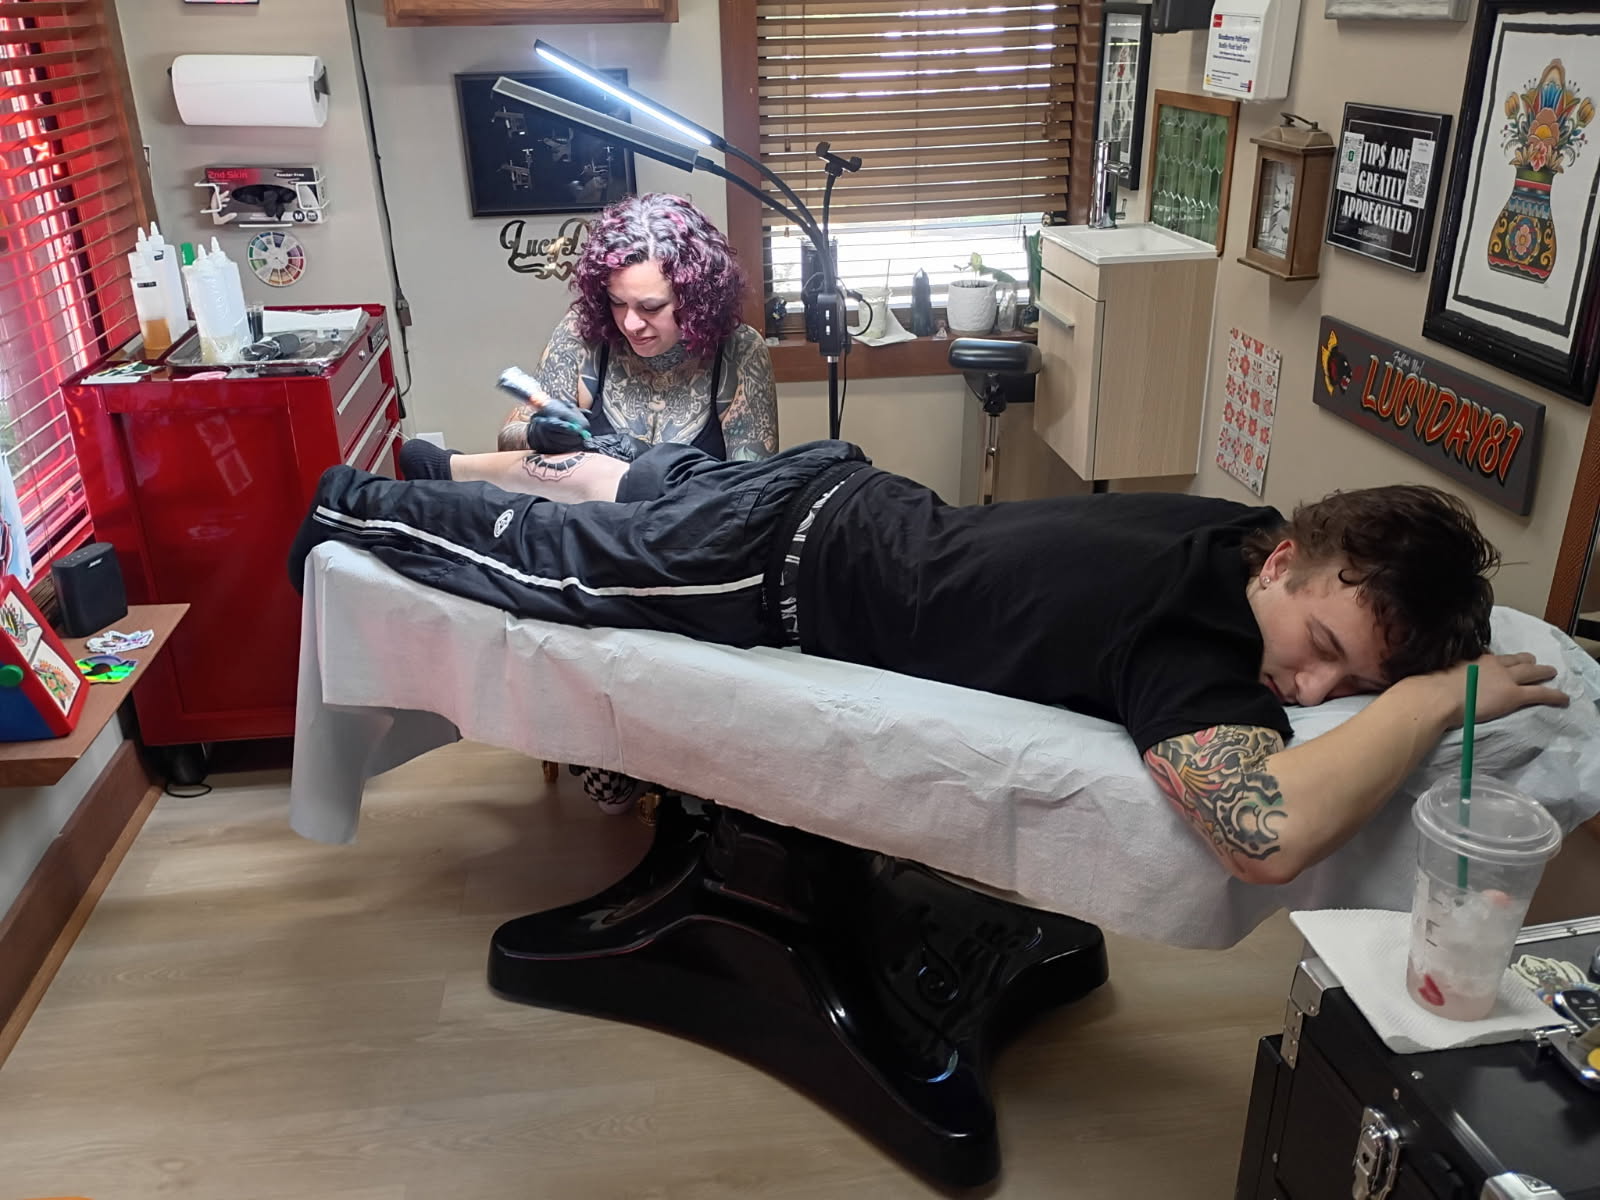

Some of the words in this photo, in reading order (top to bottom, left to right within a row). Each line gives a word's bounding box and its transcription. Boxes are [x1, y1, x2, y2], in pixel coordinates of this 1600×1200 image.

[207, 170, 226, 179] 2nd
[226, 169, 248, 179] Skin
[1387, 146, 1411, 173] ARE
[1358, 170, 1406, 202] GREATLY
[1341, 195, 1413, 235] APPRECIATED
[1361, 354, 1524, 486] LUCYDAY81
